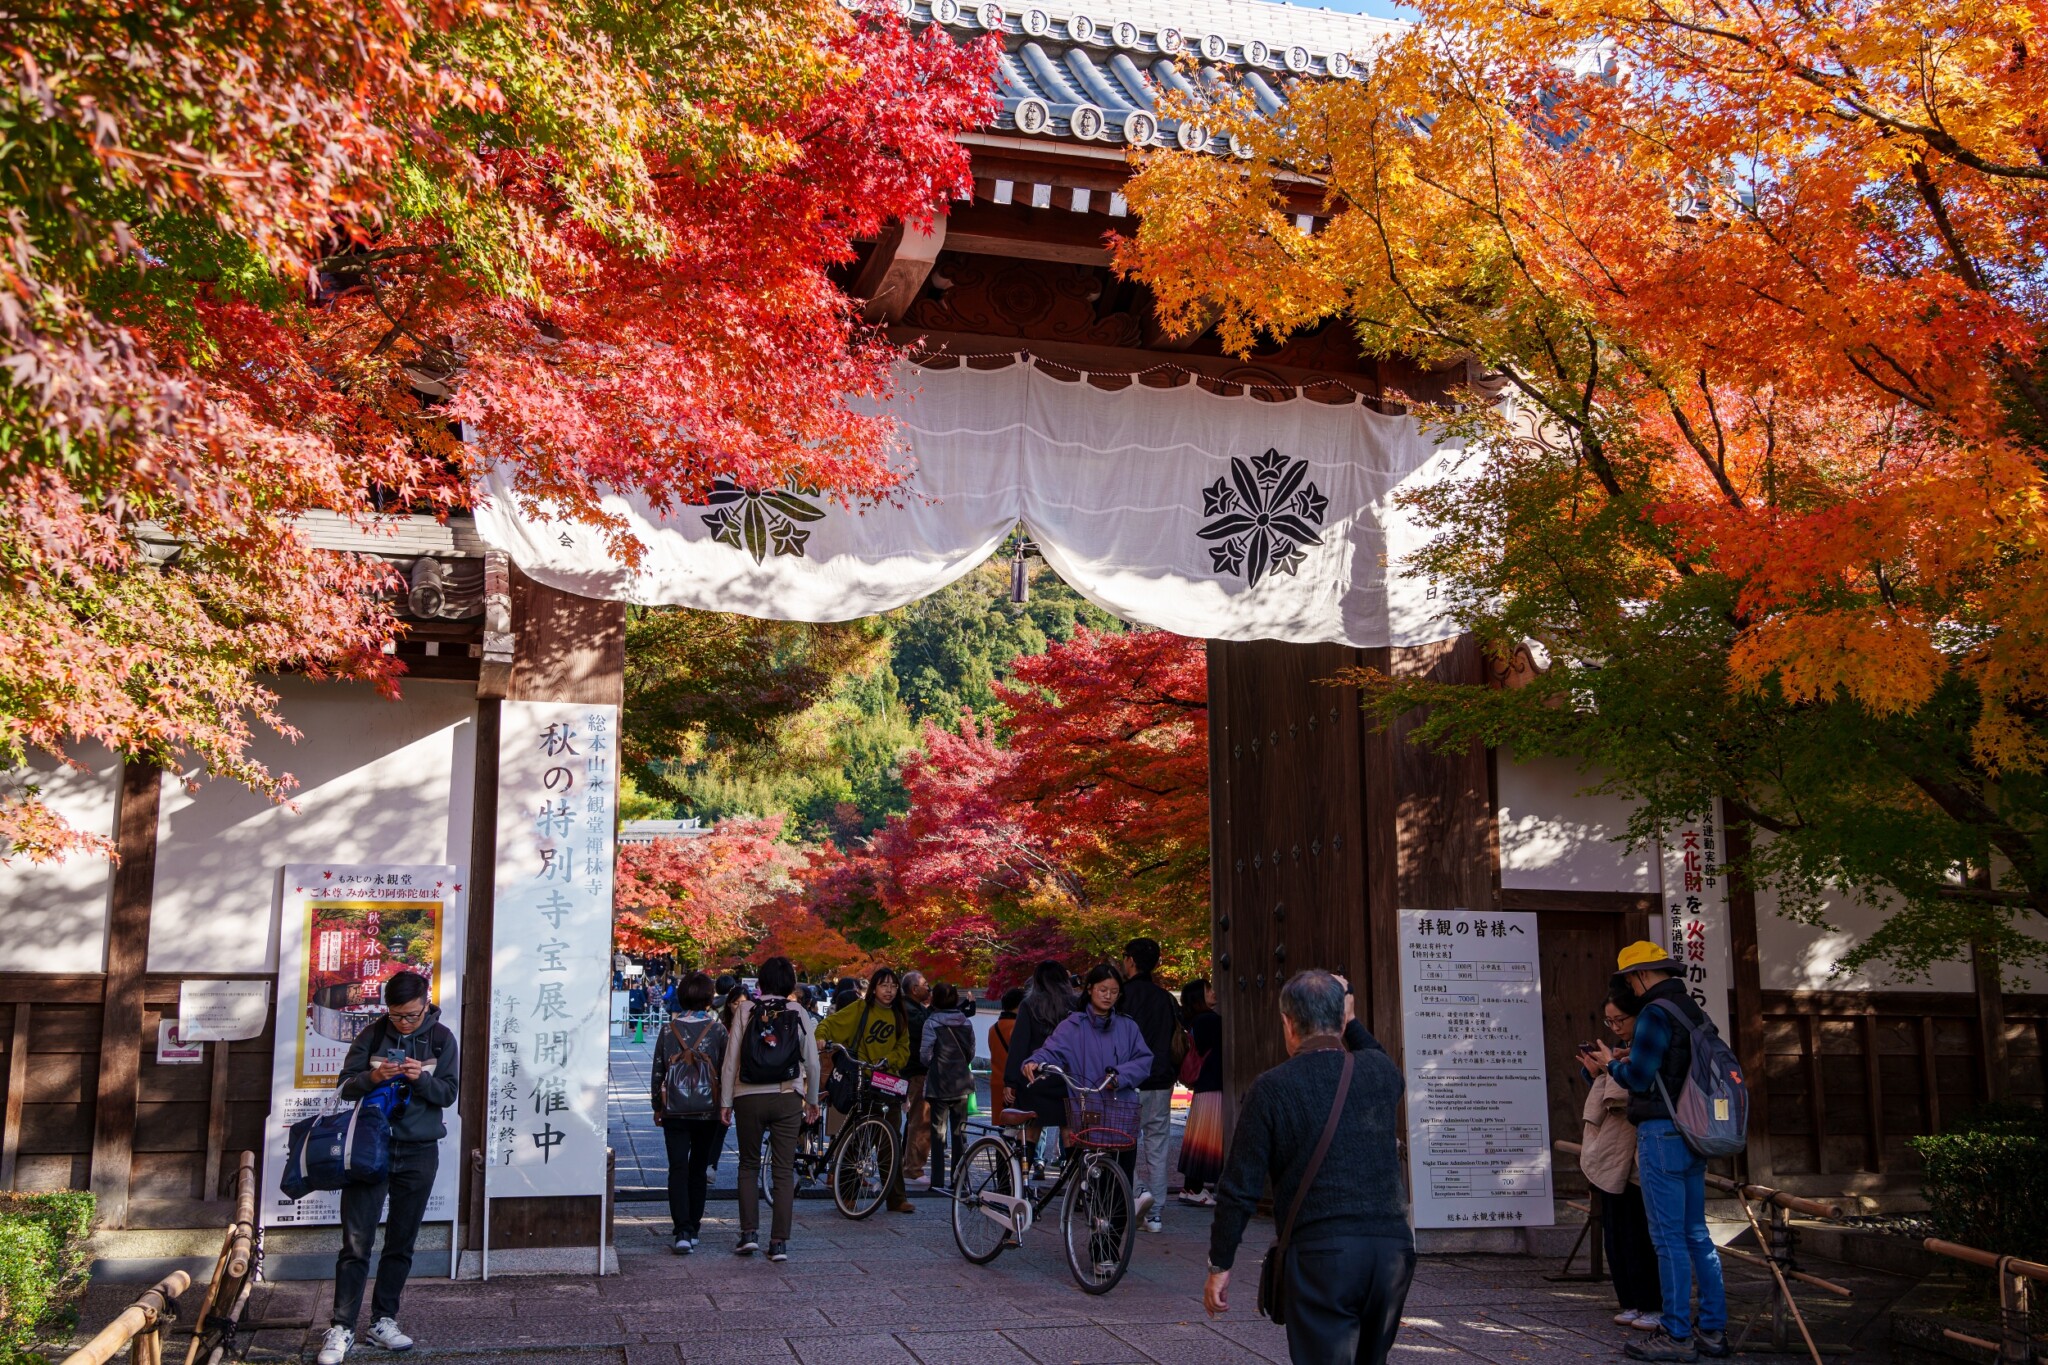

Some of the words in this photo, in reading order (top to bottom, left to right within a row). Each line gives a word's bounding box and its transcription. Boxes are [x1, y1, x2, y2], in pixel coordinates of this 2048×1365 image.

[584, 713, 607, 897] 総本山永観堂禅林寺
[338, 874, 413, 886] もみじの永観堂
[310, 888, 343, 899] ご本尊
[345, 887, 441, 900] みかえり阿弥陀如来
[1417, 918, 1525, 938] 拝観の皆様へ
[528, 722, 582, 1165] 秋の特別寺宝展開催中
[1408, 942, 1454, 950] 拝観は有料です
[361, 911, 382, 998] 秋の永観堂
[865, 1020, 895, 1045] go
[310, 1047, 337, 1058] 11.11
[310, 1062, 336, 1073] 11.11
[499, 995, 521, 1166] 午後四時受付終了
[294, 1097, 322, 1107] 永観堂
[1502, 1178, 1515, 1186] 700
[1447, 1214, 1469, 1222] 総本山
[1471, 1211, 1524, 1222] 永観堂禅林寺
